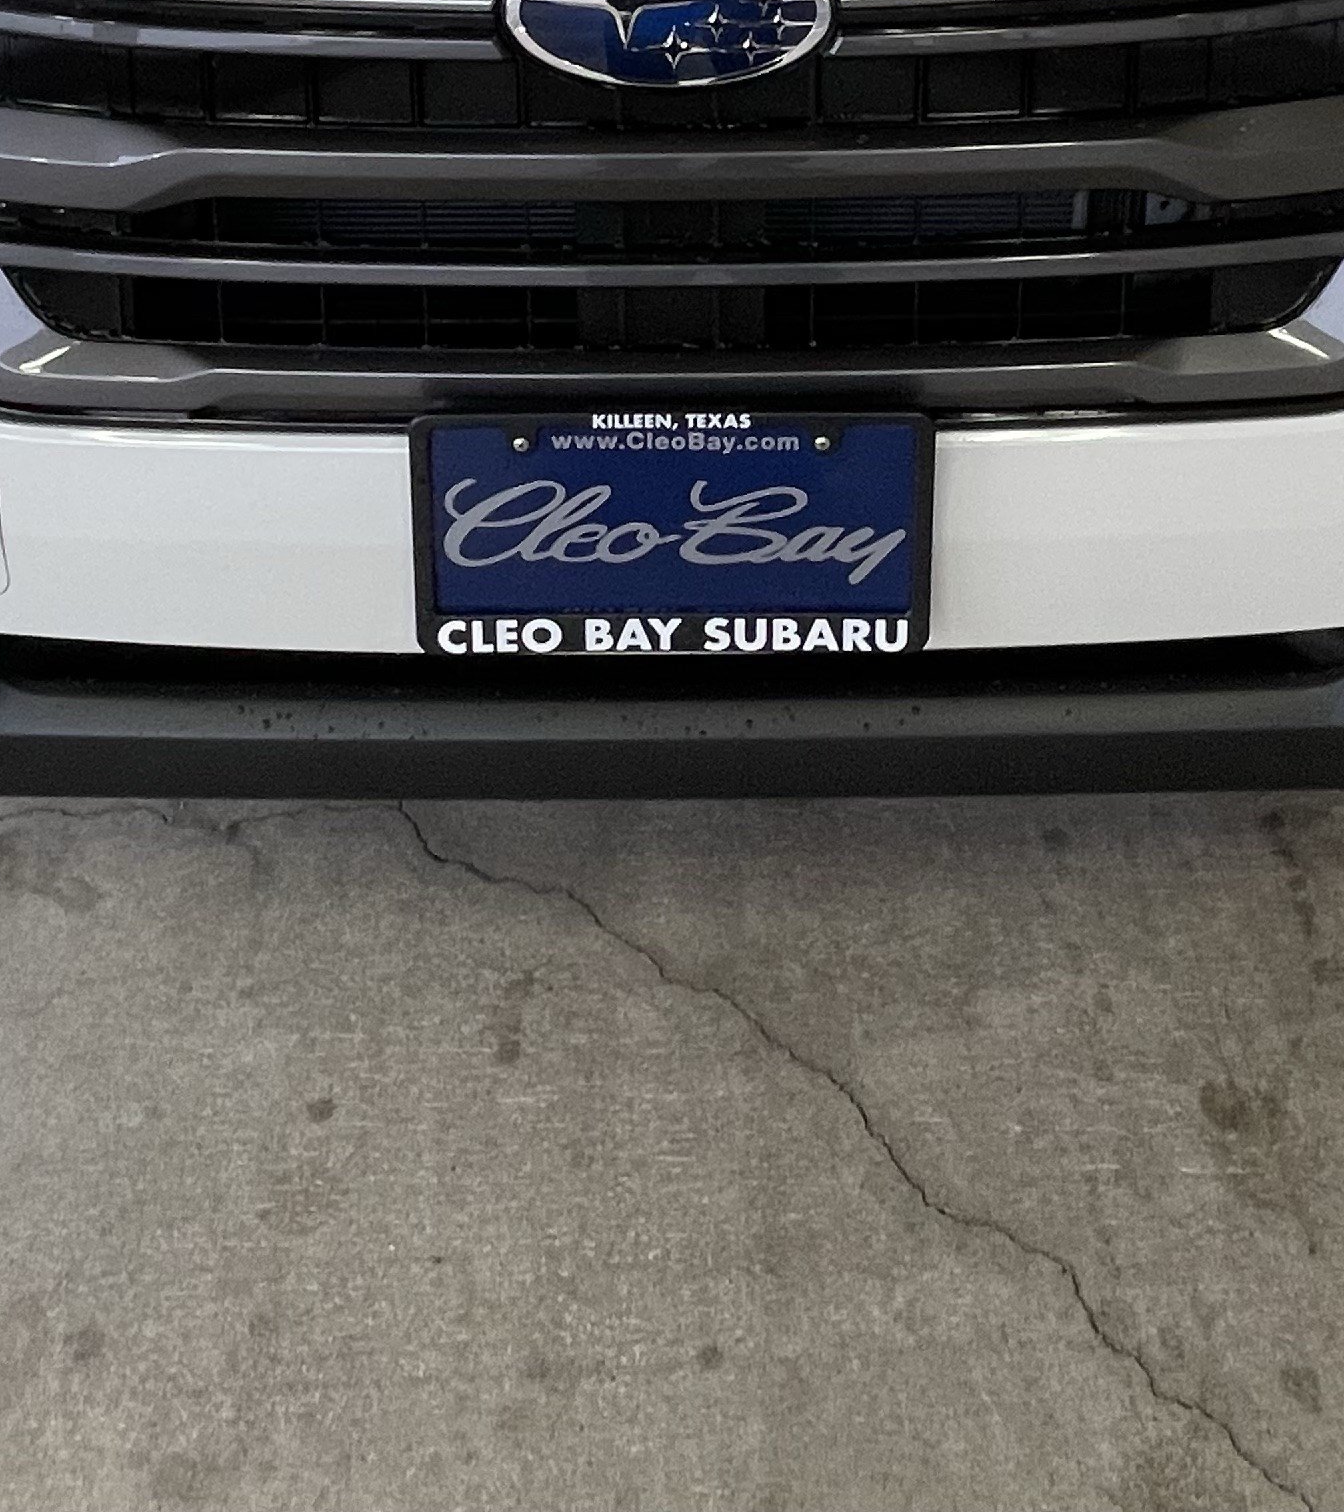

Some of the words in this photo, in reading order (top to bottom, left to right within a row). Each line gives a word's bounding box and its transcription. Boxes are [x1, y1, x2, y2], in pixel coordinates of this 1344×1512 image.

[592, 414, 679, 431] KILLEEN,
[685, 414, 751, 429] TEXAS
[551, 431, 800, 454] www.CleoBay.com
[444, 478, 680, 568] Cleo
[677, 480, 907, 585] Bay
[437, 619, 563, 654] CLEO
[585, 619, 683, 652] BAY
[703, 618, 909, 653] SUBARU
